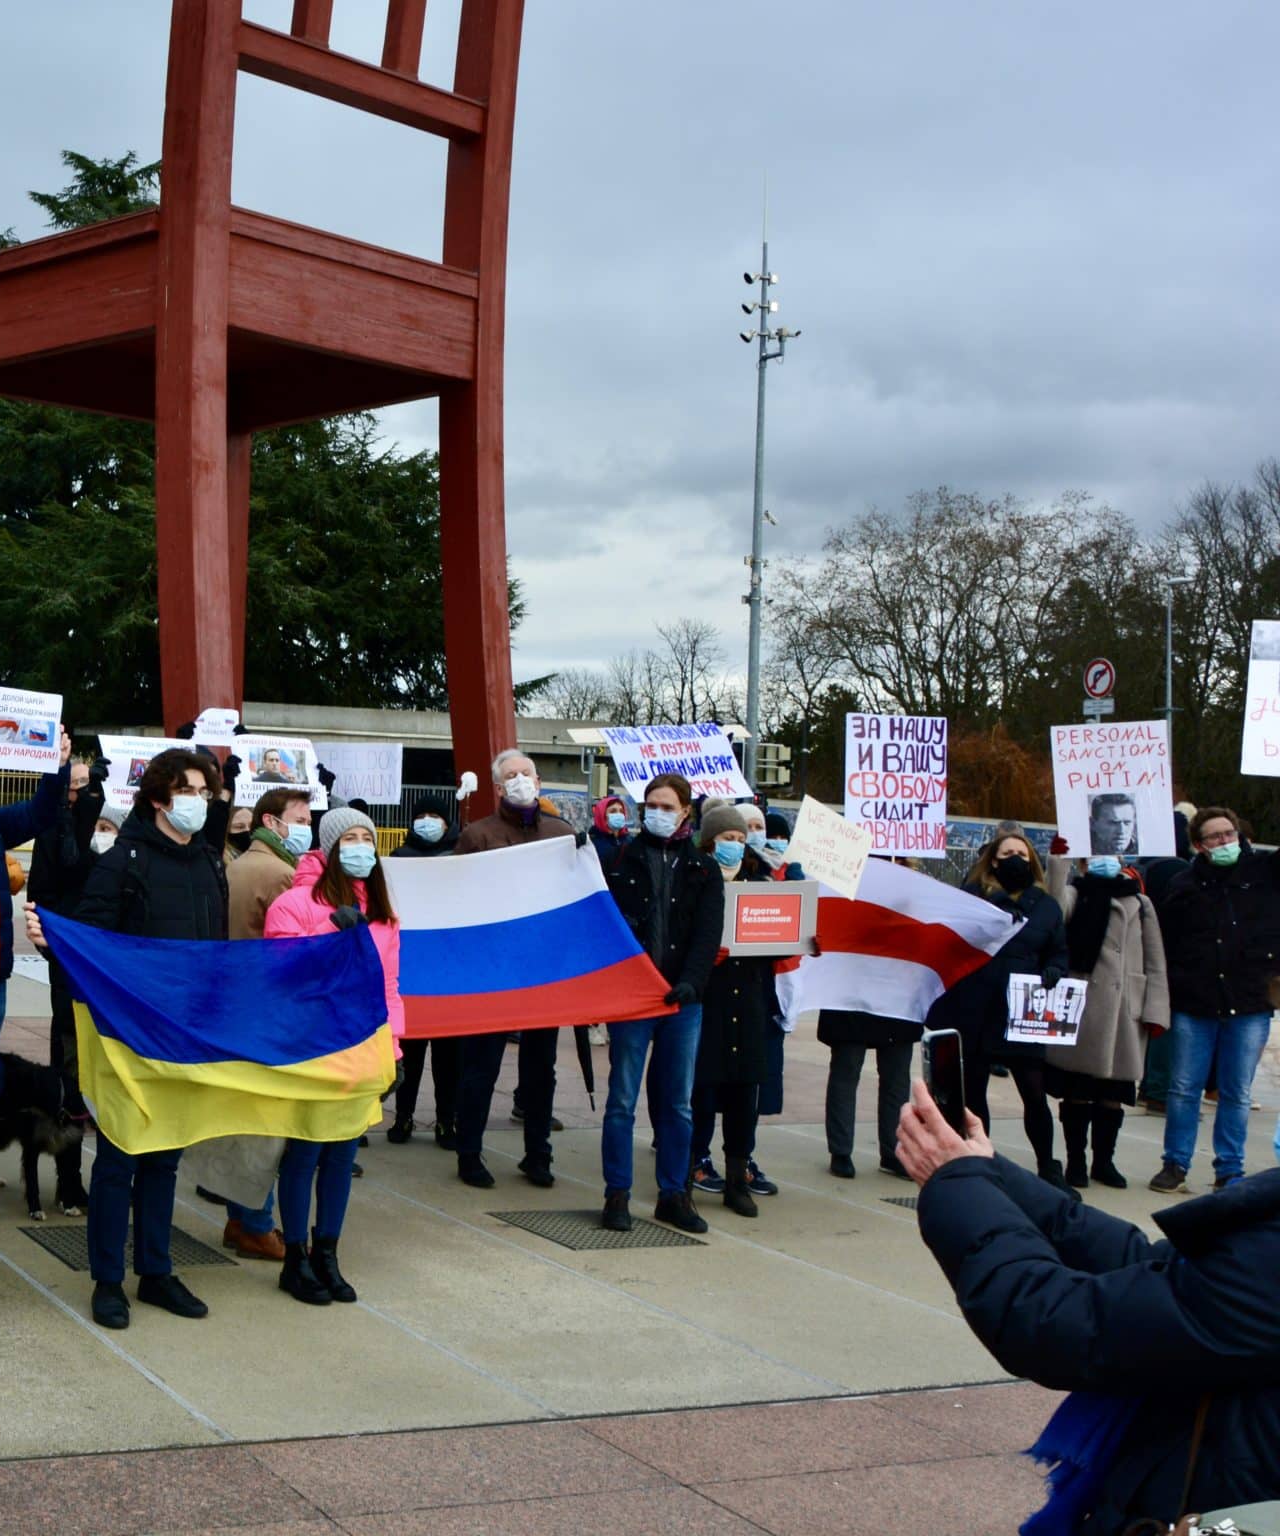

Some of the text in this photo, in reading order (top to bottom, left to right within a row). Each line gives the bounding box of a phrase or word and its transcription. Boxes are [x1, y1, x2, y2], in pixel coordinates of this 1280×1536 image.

[605, 729, 642, 745] НАШ
[852, 716, 946, 745] ЗА НАШУ
[1056, 725, 1160, 745] PERSONAL
[14, 748, 58, 760] НАРОДАМ!
[640, 741, 702, 759] НЕ ПУТИН
[858, 743, 946, 775] И ВАШУ
[1058, 742, 1167, 762] SANCTIONS
[620, 761, 647, 782] НАШ
[705, 755, 733, 775] ВРАГ
[1067, 763, 1166, 789] PUTIN!
[1100, 761, 1126, 771] ON
[848, 771, 948, 803] СВОБОДУ
[808, 808, 825, 828] WE
[860, 801, 930, 821] СИДИТ
[858, 820, 947, 850] АВАЛЬНЫЙ
[743, 906, 781, 917] Я против
